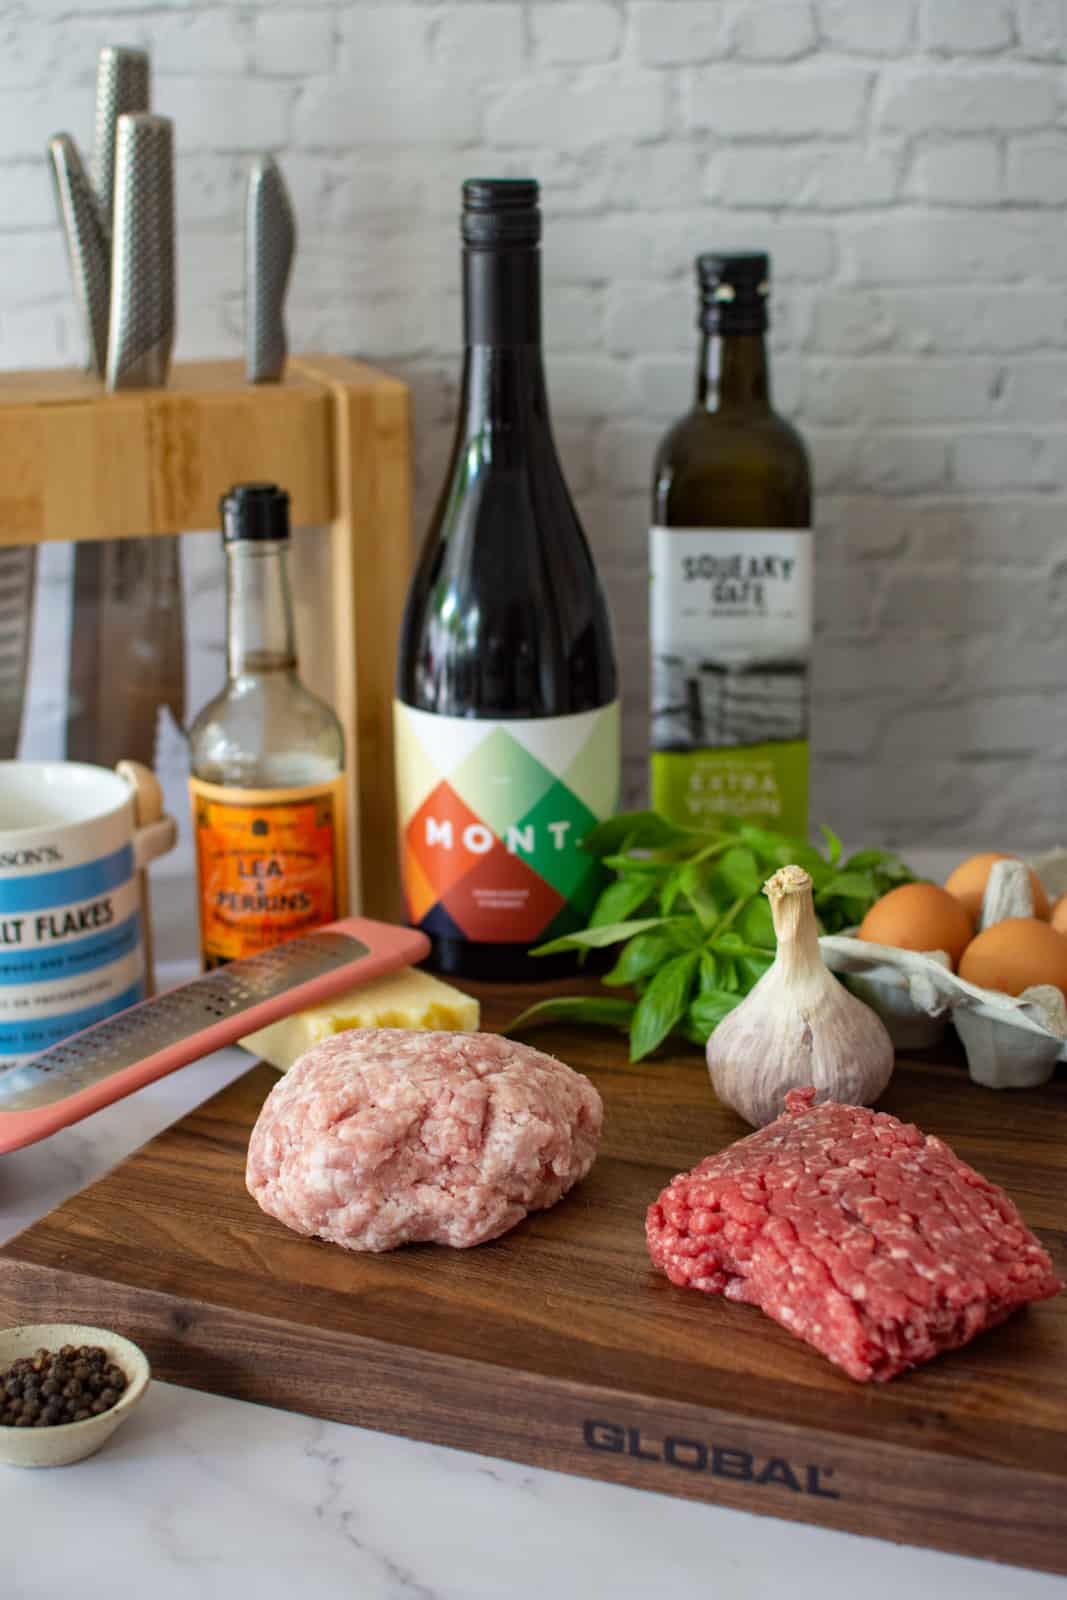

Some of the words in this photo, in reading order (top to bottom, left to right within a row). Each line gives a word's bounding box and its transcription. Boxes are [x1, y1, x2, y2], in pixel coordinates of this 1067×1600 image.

[681, 554, 796, 582] SQUEAKY
[712, 581, 766, 607] GATE
[689, 772, 777, 793] EXTRA
[238, 859, 283, 878] LEA
[217, 889, 312, 913] PERRINS
[0, 918, 24, 944] LT
[36, 898, 113, 941] FLAKES
[582, 1418, 841, 1500] GLOBAL
